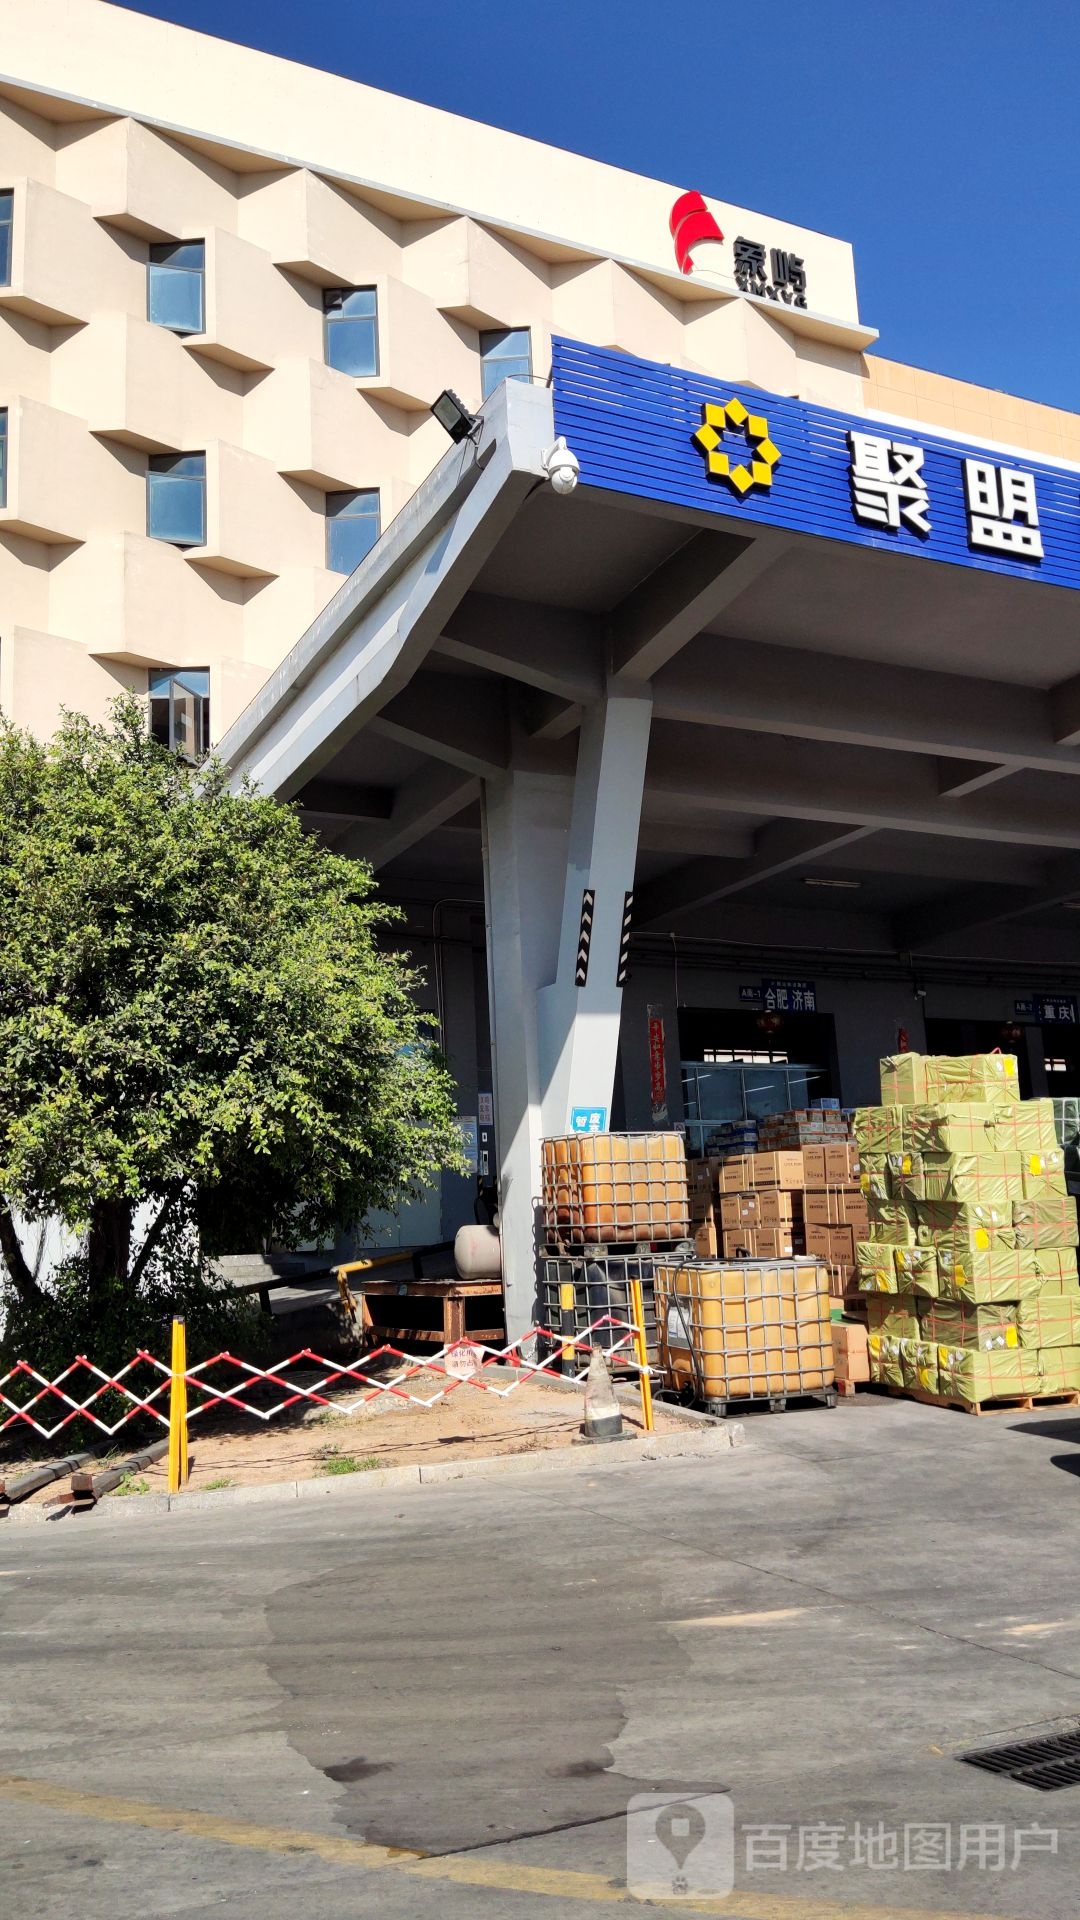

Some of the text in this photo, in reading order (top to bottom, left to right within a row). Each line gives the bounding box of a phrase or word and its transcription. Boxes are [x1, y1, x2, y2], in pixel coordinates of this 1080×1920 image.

[733, 236, 806, 293] 象屿
[848, 431, 1045, 562] 聚盟
[764, 987, 816, 1012] 合肥 济南
[1043, 1004, 1070, 1020] 重庆
